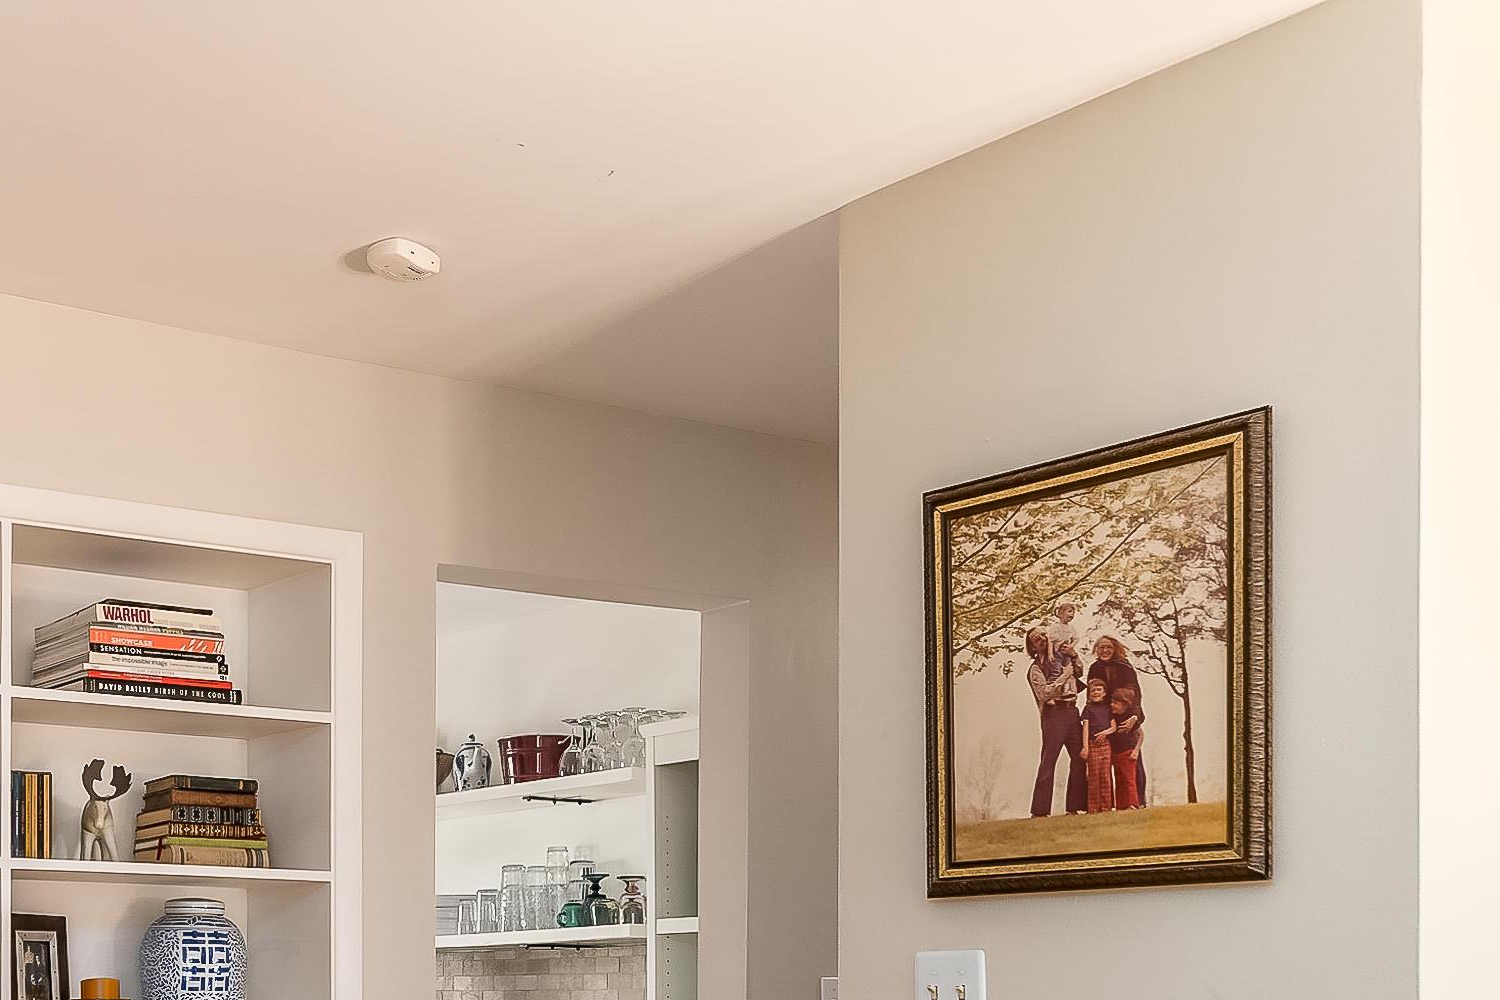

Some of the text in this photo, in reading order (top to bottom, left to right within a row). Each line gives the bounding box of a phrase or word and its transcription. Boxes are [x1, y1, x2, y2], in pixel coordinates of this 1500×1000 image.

[102, 605, 155, 625] WARHOL
[110, 636, 154, 647] SHOWCASE
[100, 644, 143, 655] SENSATION
[98, 682, 123, 692] DAVID
[207, 691, 226, 700] COOL
